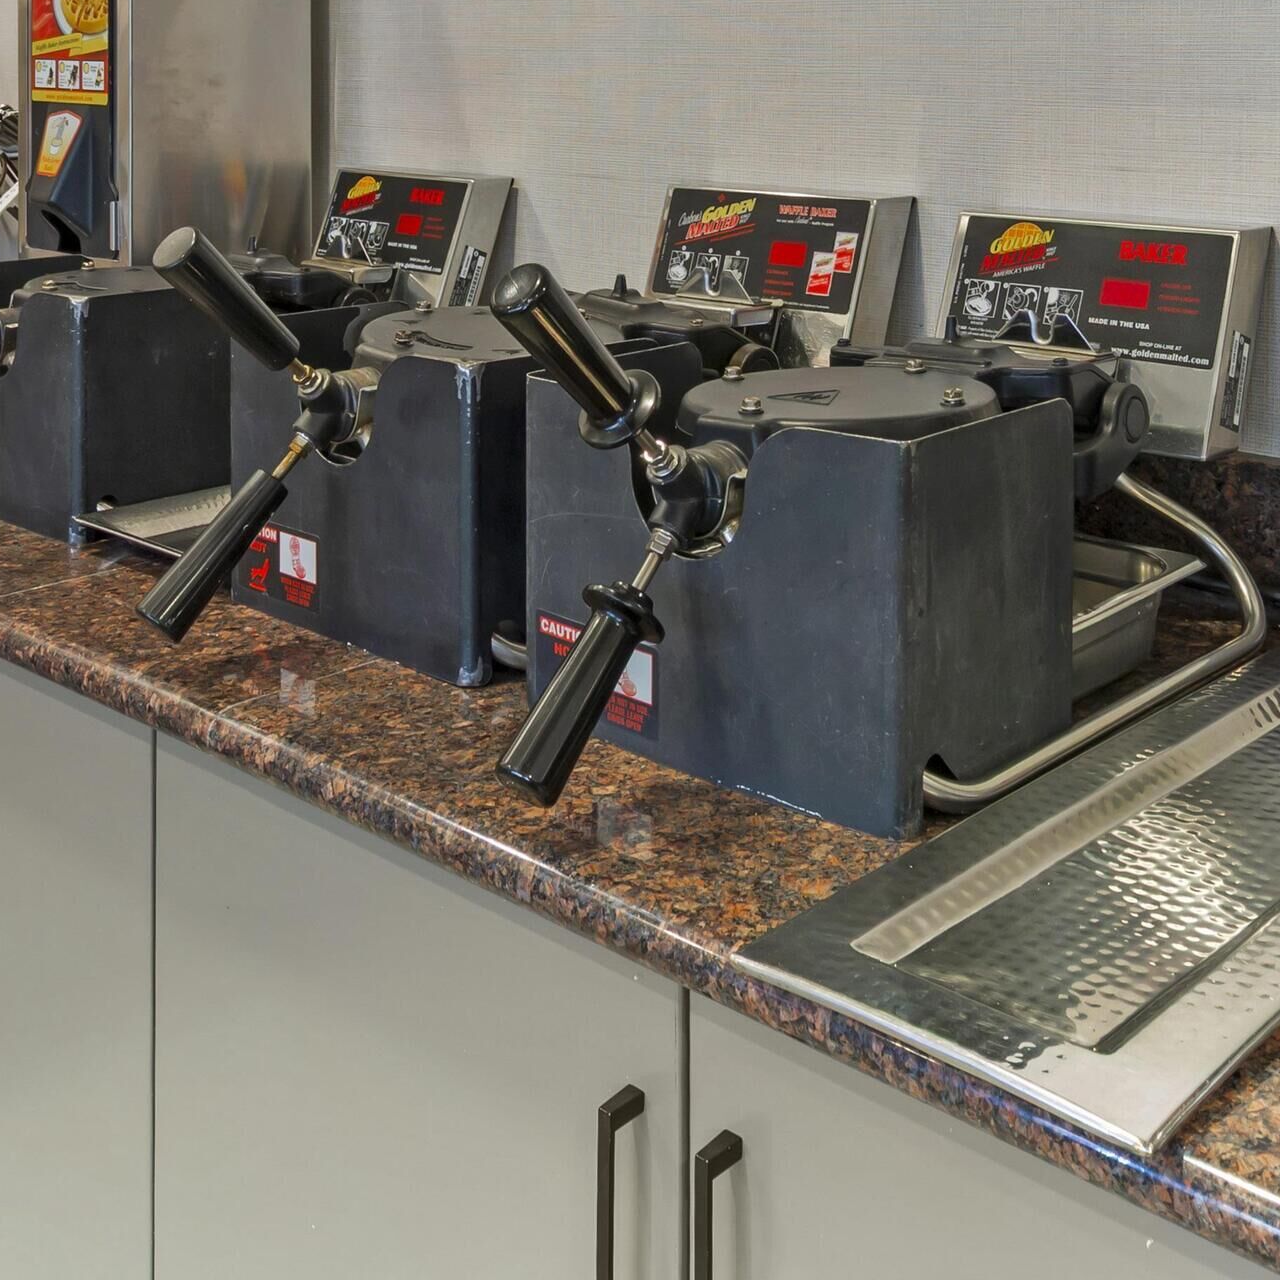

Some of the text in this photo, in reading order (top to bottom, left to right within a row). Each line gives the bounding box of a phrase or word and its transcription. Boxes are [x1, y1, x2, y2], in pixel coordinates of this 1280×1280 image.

[702, 197, 757, 224] GOLDEN
[990, 229, 1055, 254] GOLDEN
[1118, 240, 1189, 265] BAKER
[1088, 317, 1150, 330] MADE IN THE USA
[540, 617, 581, 643] CAUTI
